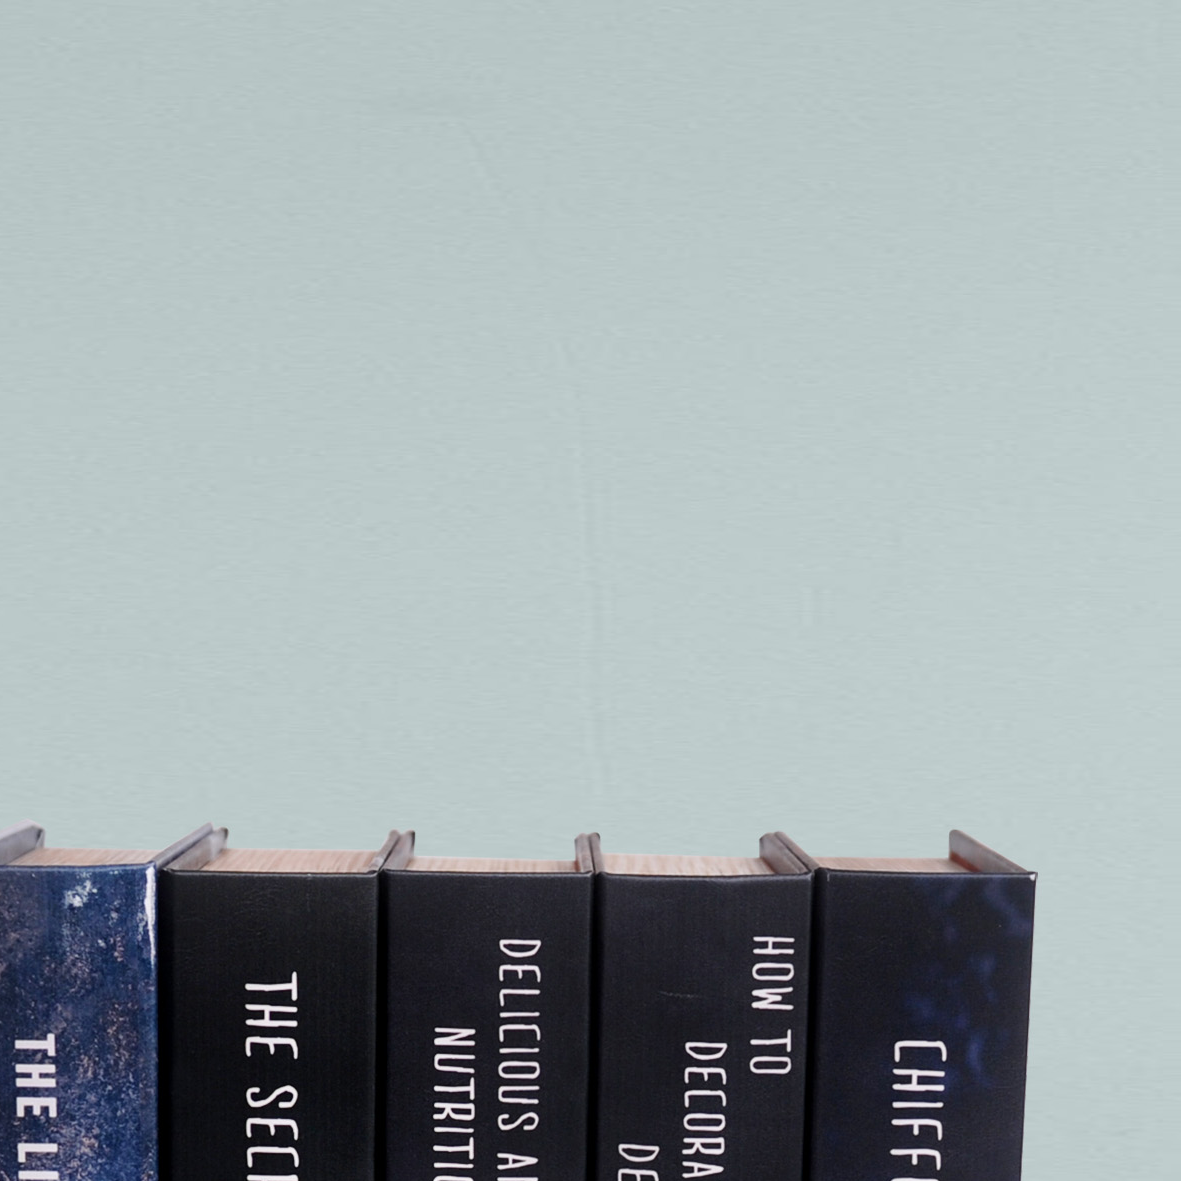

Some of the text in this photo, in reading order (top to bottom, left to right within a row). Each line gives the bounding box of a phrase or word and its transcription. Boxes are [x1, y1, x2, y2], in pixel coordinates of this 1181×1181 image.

[244, 971, 299, 1060] THE
[497, 939, 542, 1131] DELICIOUS
[749, 936, 795, 1075] HOW TO
[14, 1032, 58, 1118] THE
